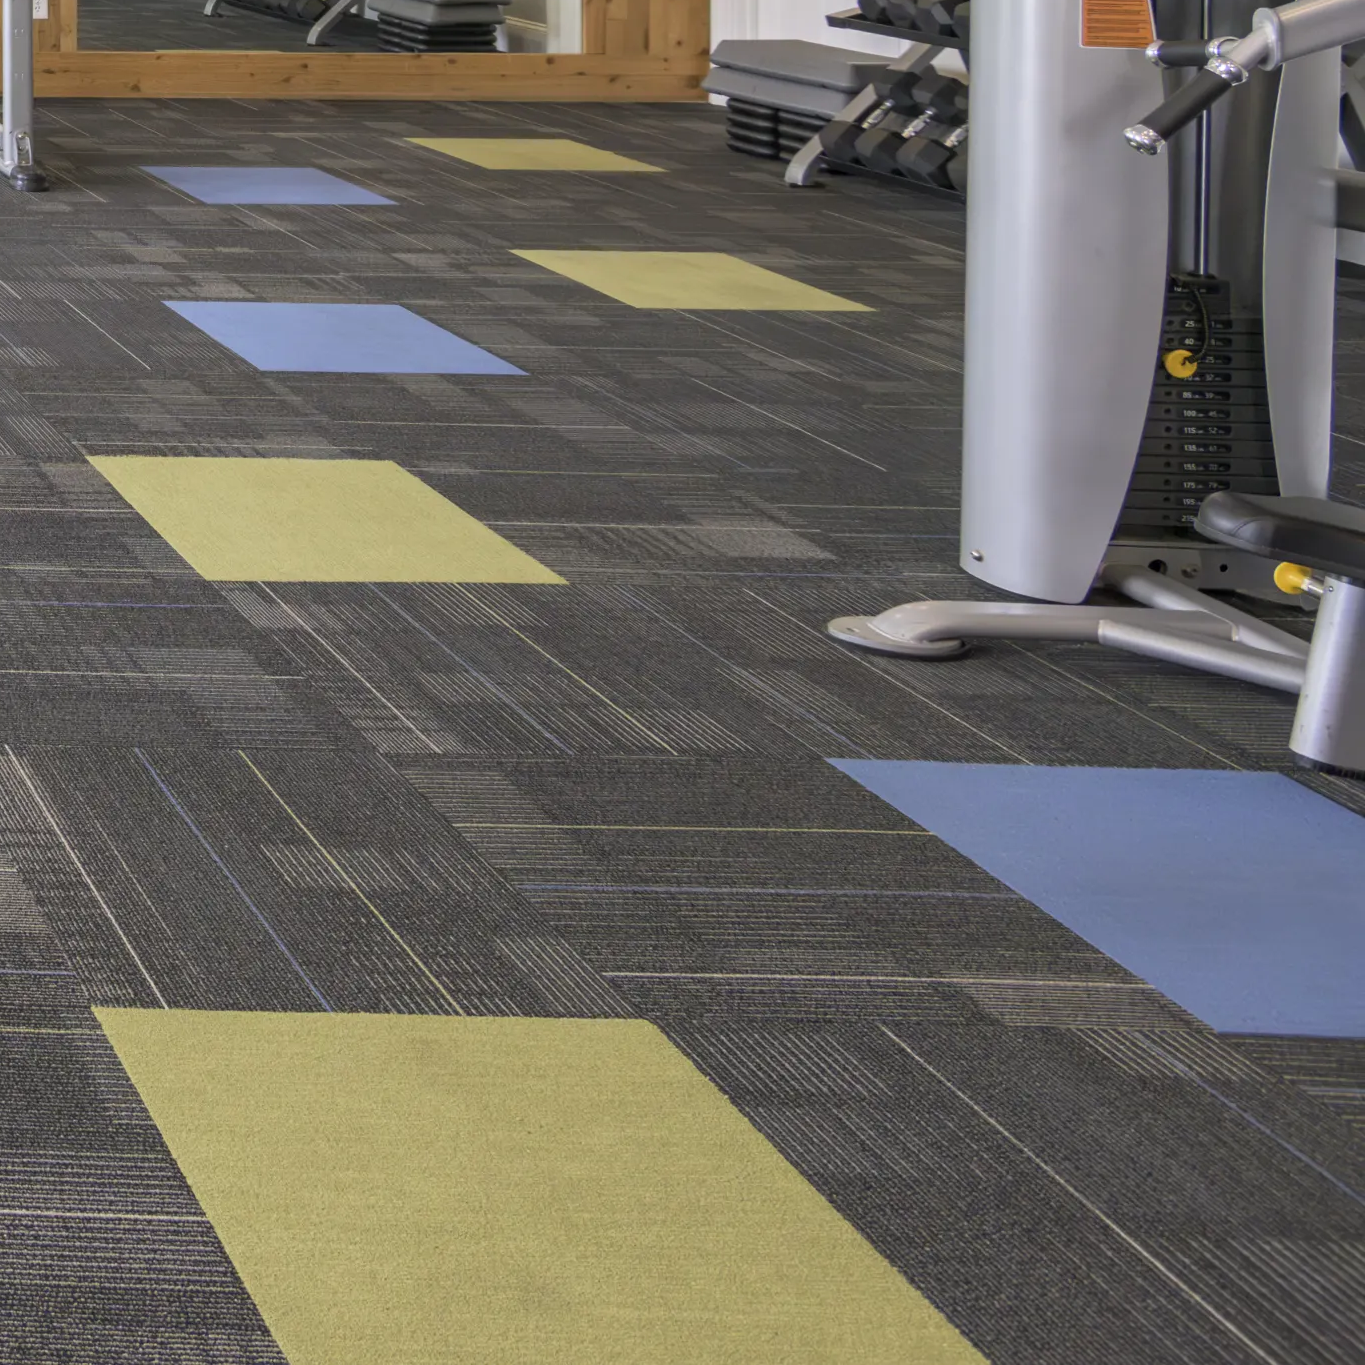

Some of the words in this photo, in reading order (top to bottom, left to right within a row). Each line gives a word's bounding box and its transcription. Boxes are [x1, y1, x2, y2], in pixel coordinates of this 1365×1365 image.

[1184, 320, 1195, 328] 25
[1184, 338, 1195, 346] 40
[1183, 409, 1197, 417] 100
[1183, 481, 1196, 489] 175
